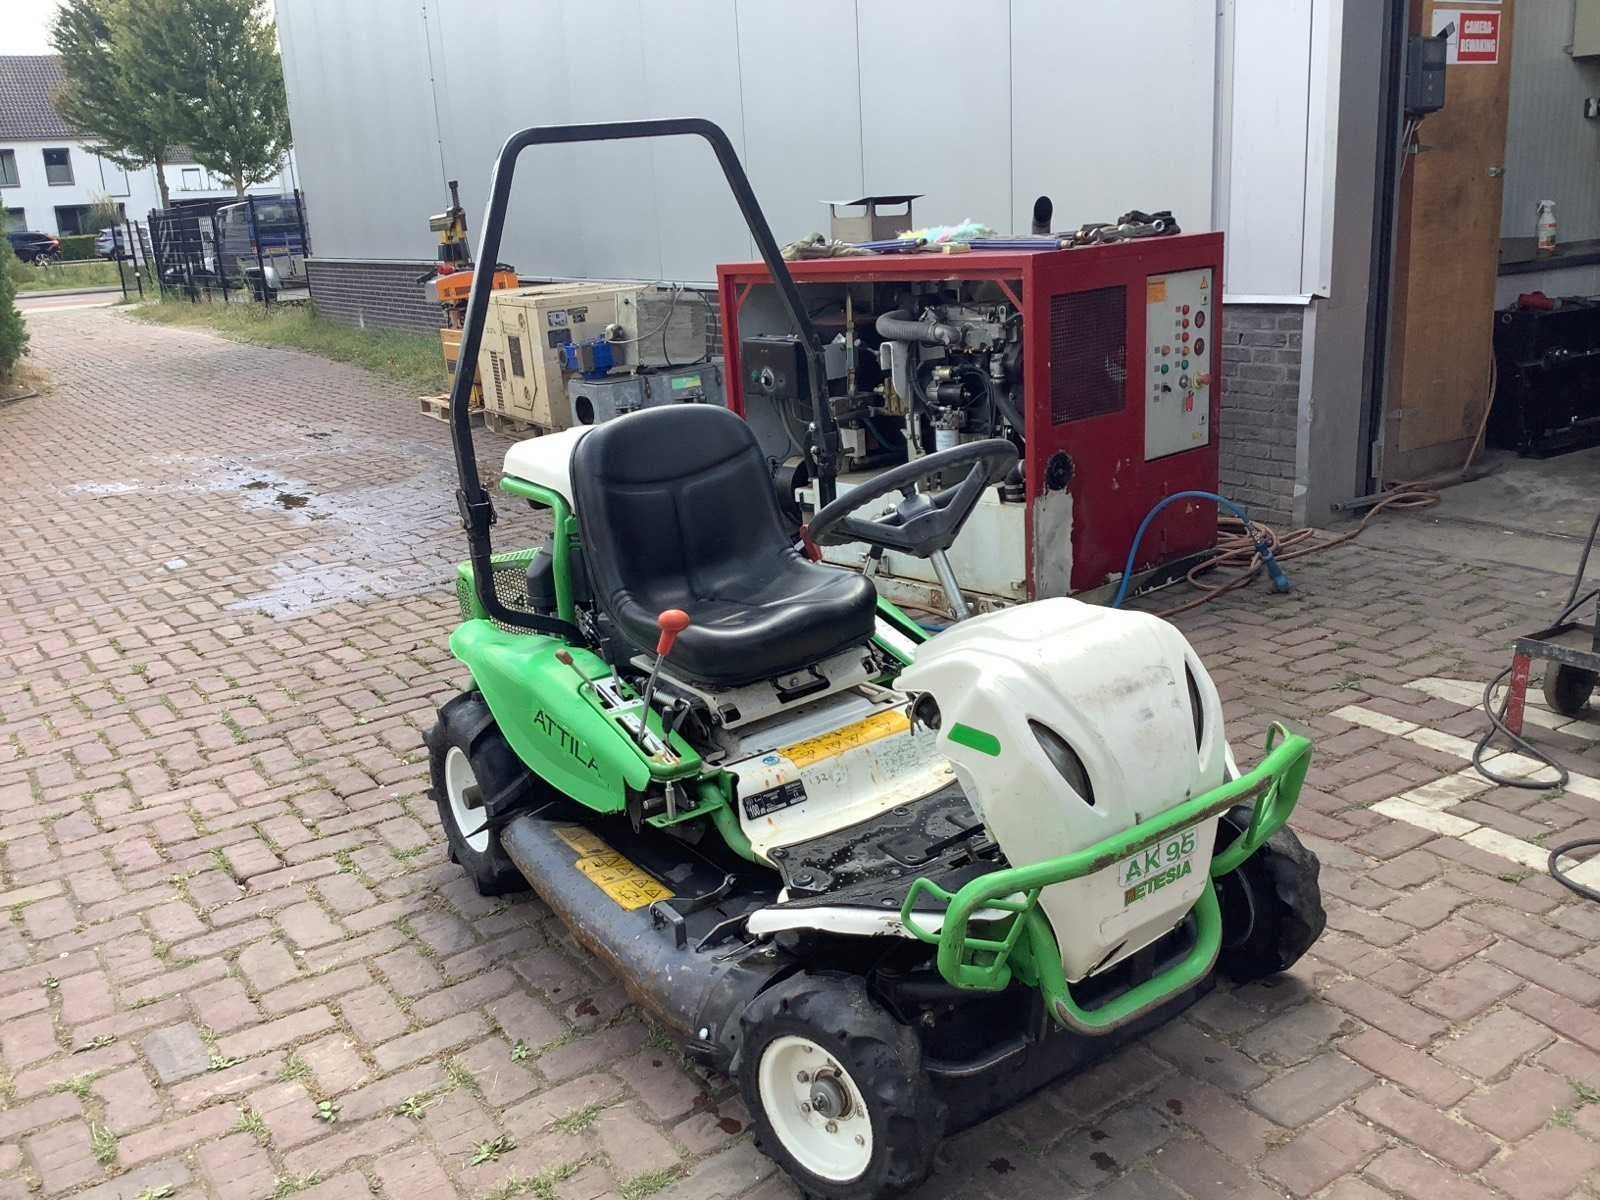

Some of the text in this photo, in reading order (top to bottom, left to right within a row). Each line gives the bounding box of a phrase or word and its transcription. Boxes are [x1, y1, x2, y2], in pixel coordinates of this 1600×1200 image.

[533, 709, 602, 778] ATTILA
[1125, 832, 1195, 882] AK 95
[1134, 859, 1192, 902] ETESIA
